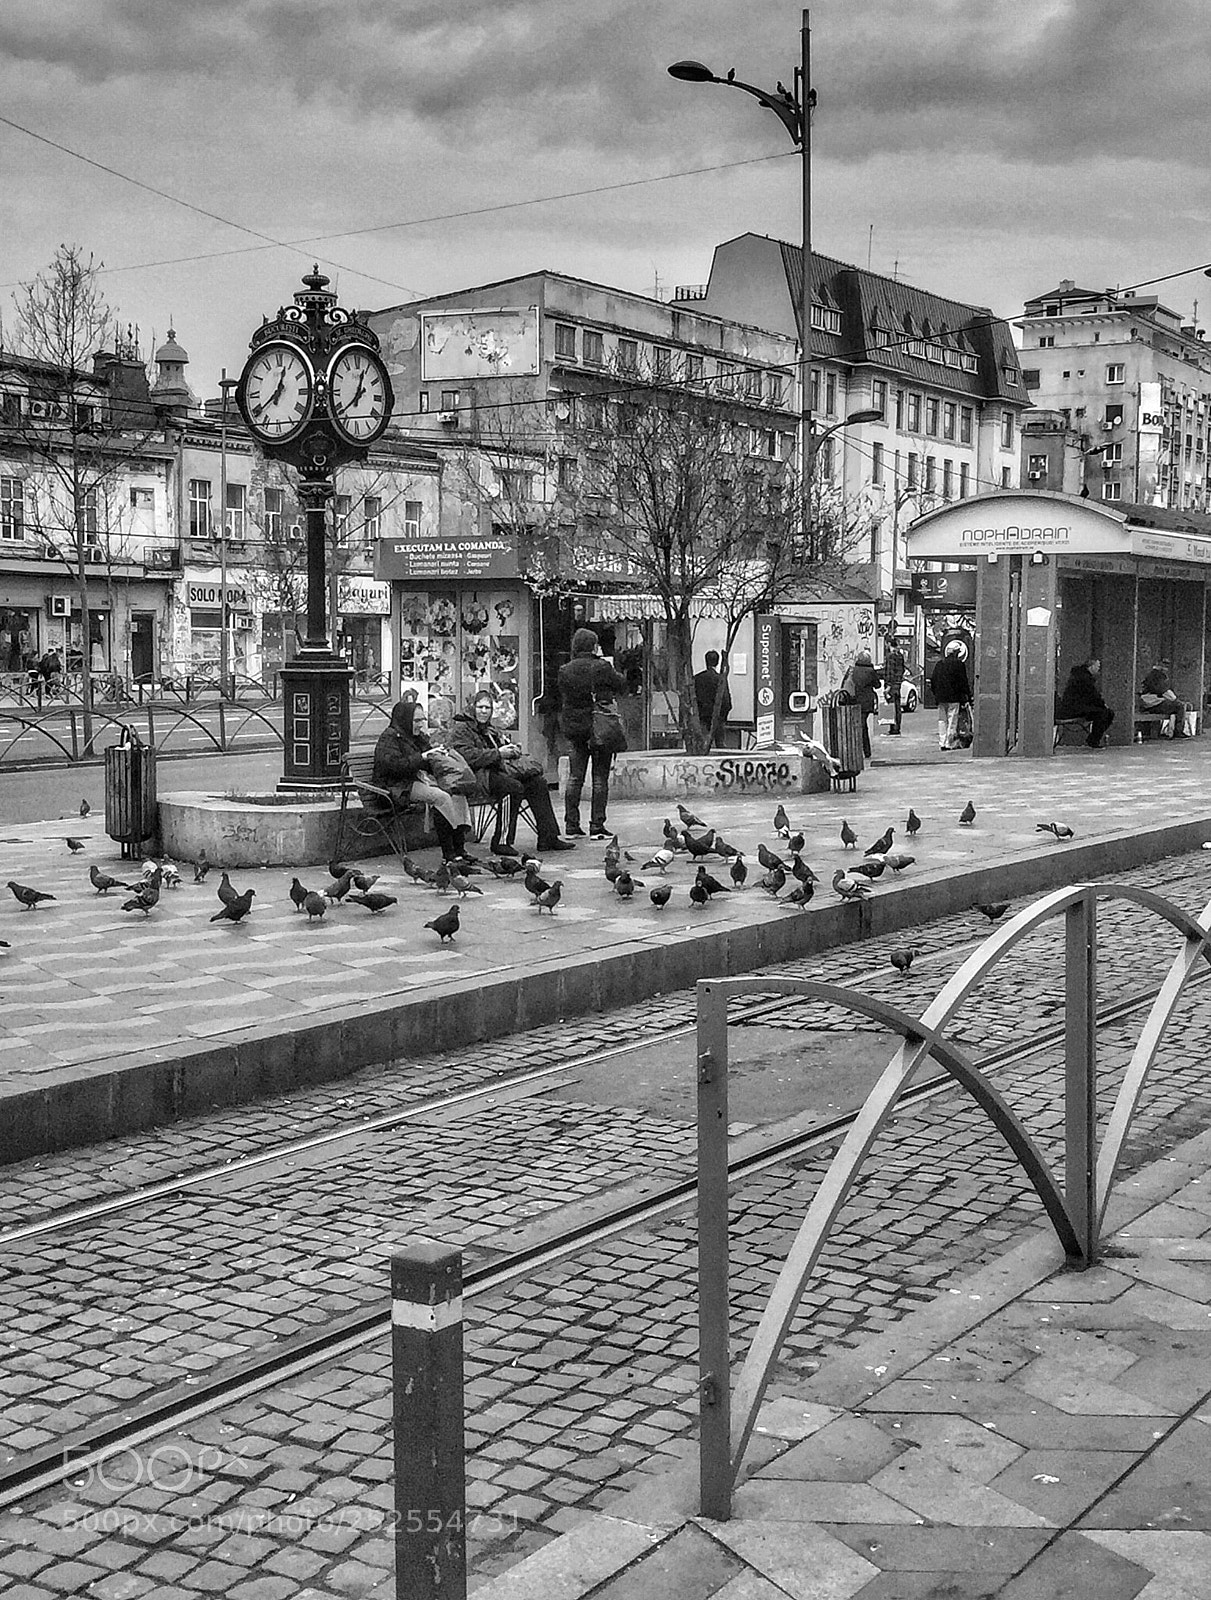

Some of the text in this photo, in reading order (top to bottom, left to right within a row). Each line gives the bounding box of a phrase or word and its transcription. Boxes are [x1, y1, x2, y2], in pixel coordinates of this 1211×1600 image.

[394, 541, 505, 553] EXECUTAM LA COMANDA
[190, 587, 215, 602] SOLO
